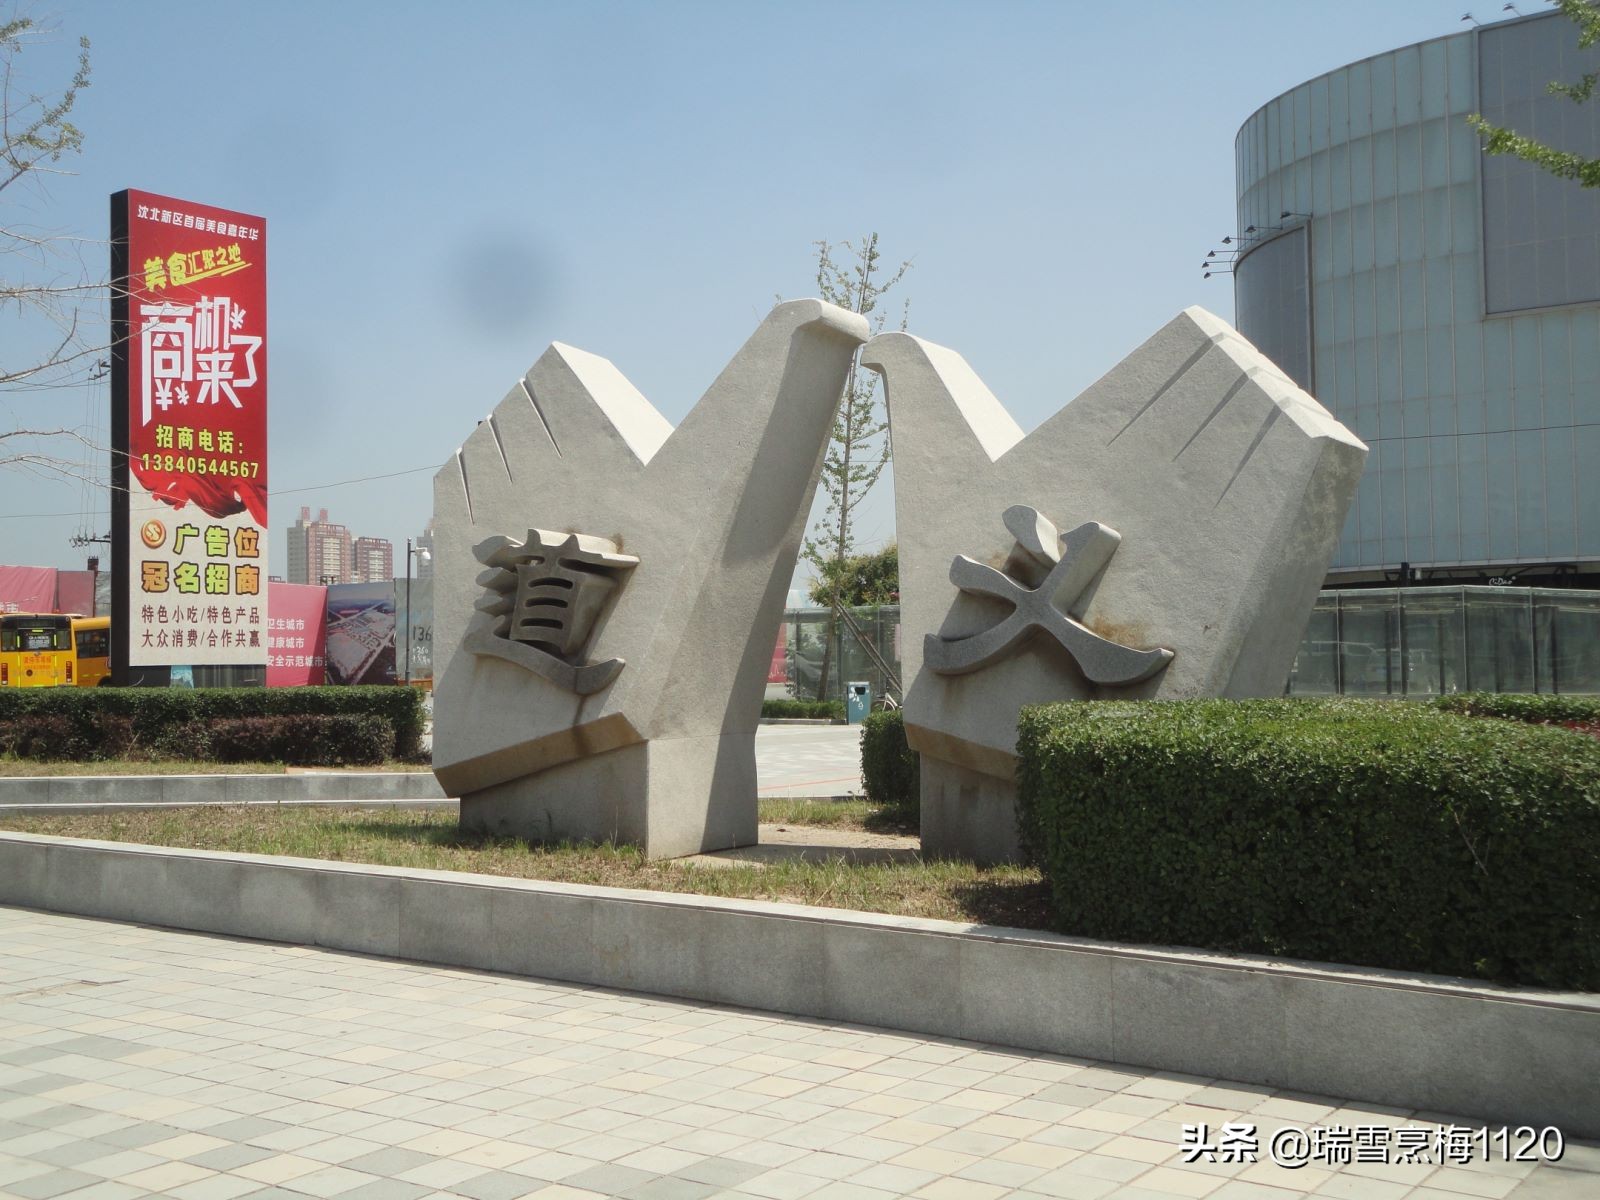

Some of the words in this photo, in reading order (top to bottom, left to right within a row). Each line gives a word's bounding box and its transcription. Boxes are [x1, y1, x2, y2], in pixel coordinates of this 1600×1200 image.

[137, 204, 259, 241] 沈北新区首届美食嘉年华
[143, 243, 243, 293] 美食汇聚之地
[141, 453, 259, 479] 13840544567
[173, 523, 260, 558] 广告位
[141, 560, 260, 595] 冠名招商
[141, 604, 260, 625] 特色小吃/特色产品
[141, 628, 261, 648] 大众消费/合作共赢
